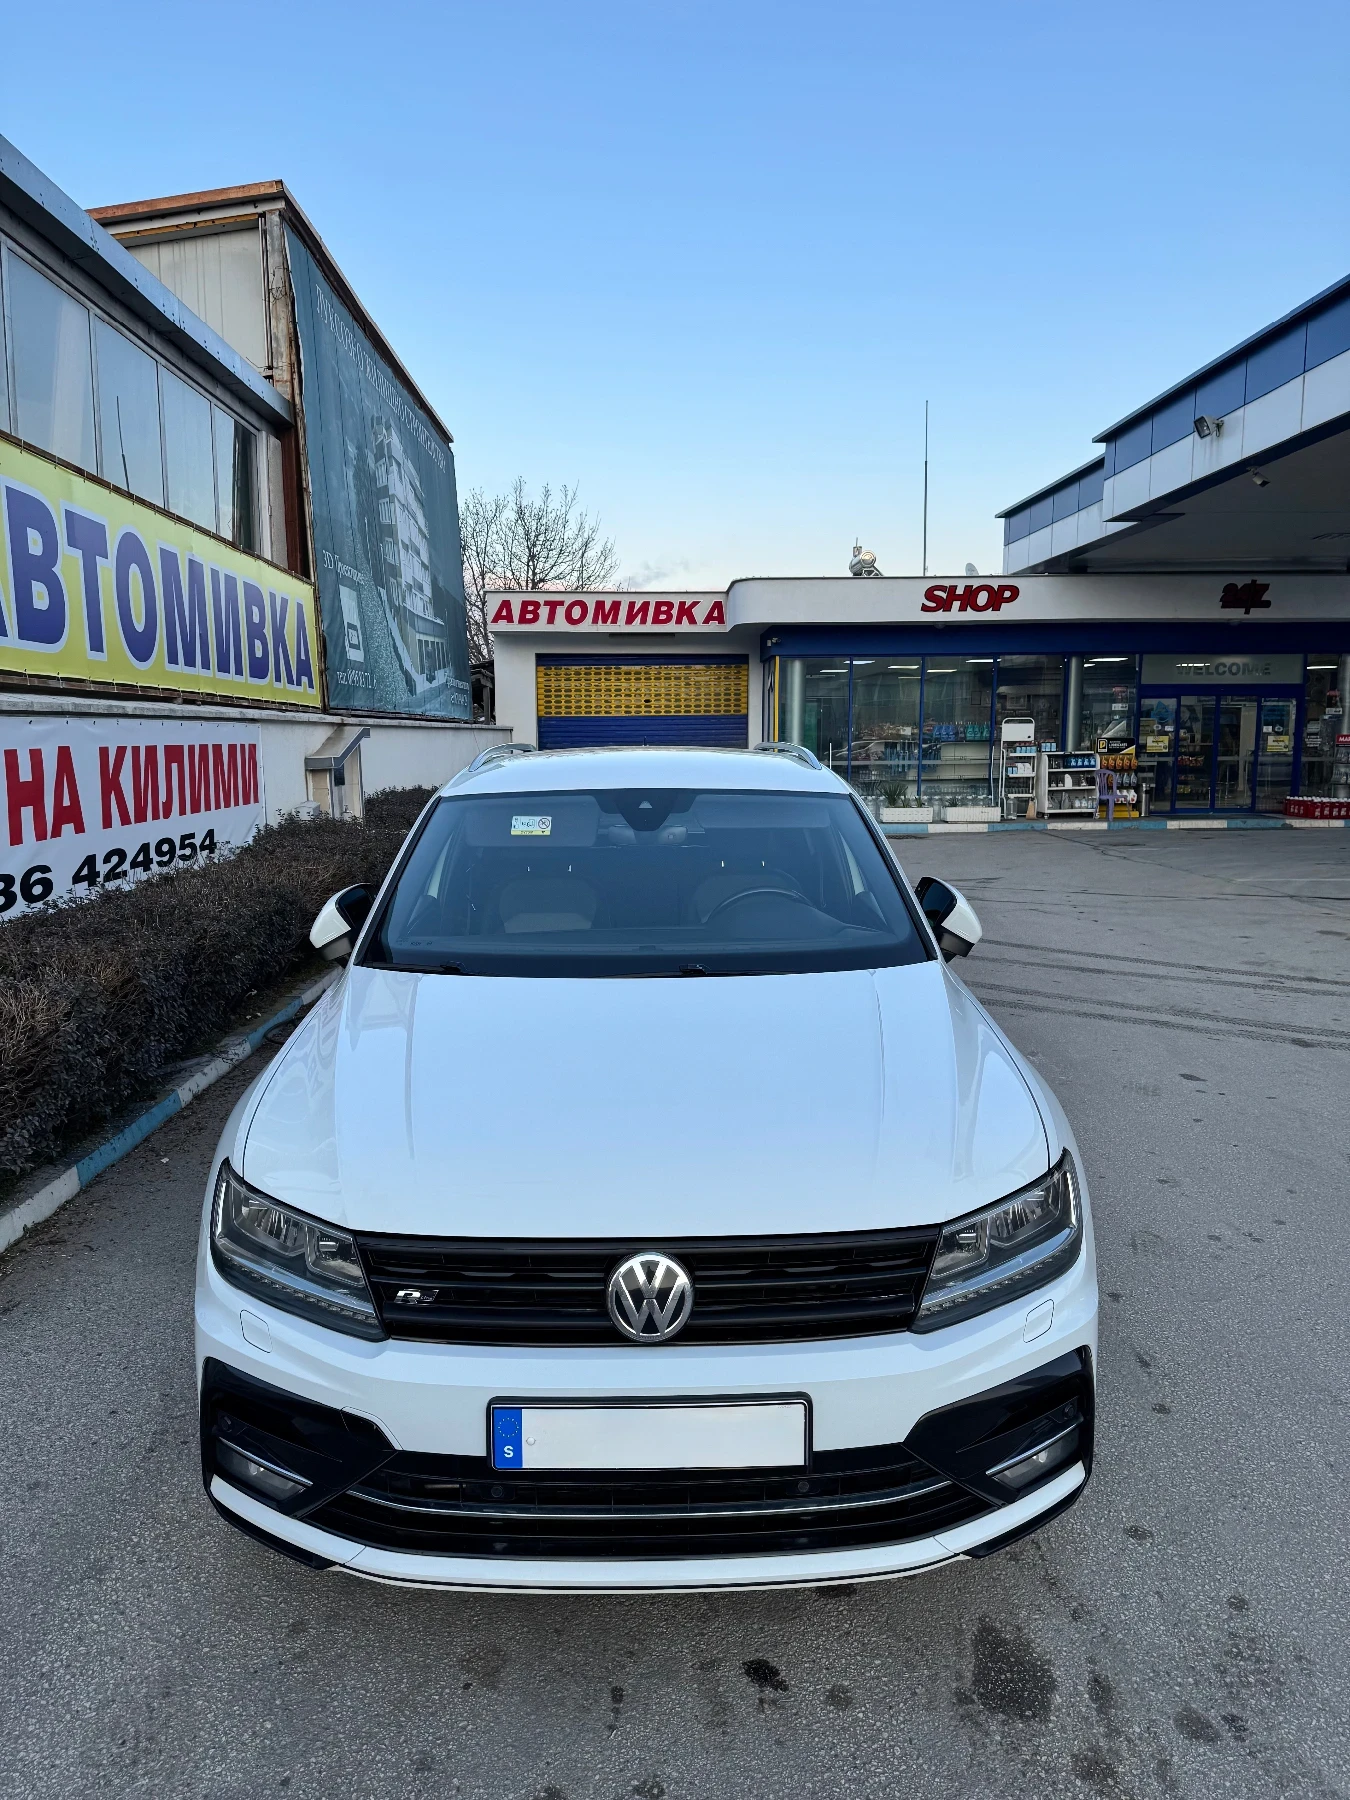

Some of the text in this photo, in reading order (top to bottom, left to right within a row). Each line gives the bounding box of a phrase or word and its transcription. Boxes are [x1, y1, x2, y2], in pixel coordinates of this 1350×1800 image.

[322, 549, 334, 569] 3D
[0, 485, 315, 690] ВТОМИВКА
[920, 584, 1020, 612] SHOP
[490, 599, 726, 625] АВТОМИВКА
[1176, 662, 1272, 676] WELCOME
[4, 743, 260, 846] НА КИЛИМИ
[72, 828, 217, 888] 424954
[394, 1289, 421, 1304] R
[503, 1445, 514, 1458] S
